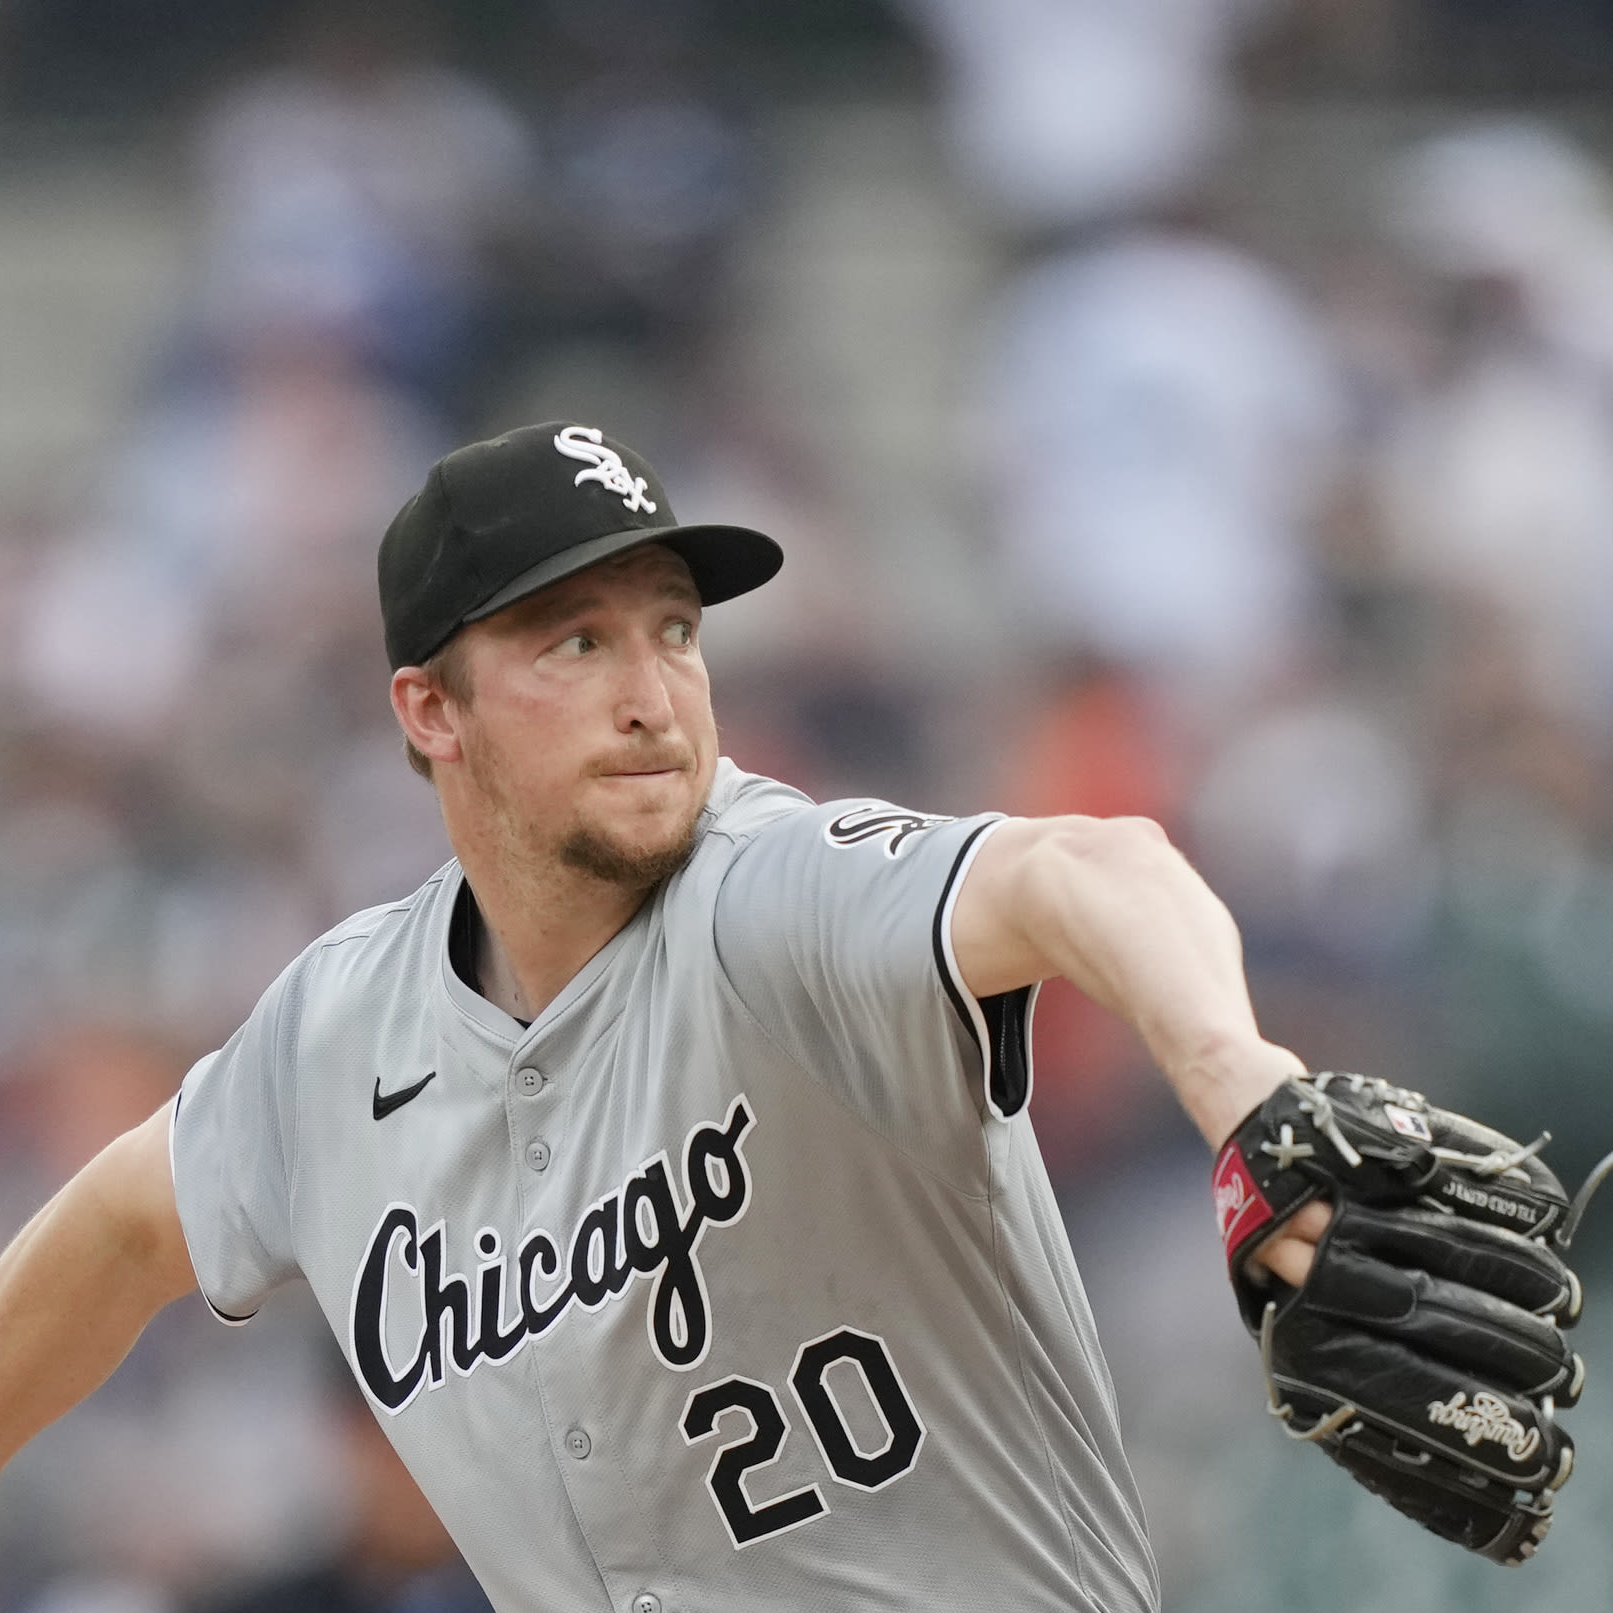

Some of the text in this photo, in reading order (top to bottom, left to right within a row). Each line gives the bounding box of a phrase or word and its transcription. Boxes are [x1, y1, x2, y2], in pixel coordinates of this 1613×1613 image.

[554, 426, 657, 514] Sox
[825, 803, 955, 860] So
[349, 1094, 757, 1416] Chicago
[678, 1324, 927, 1550] 20
